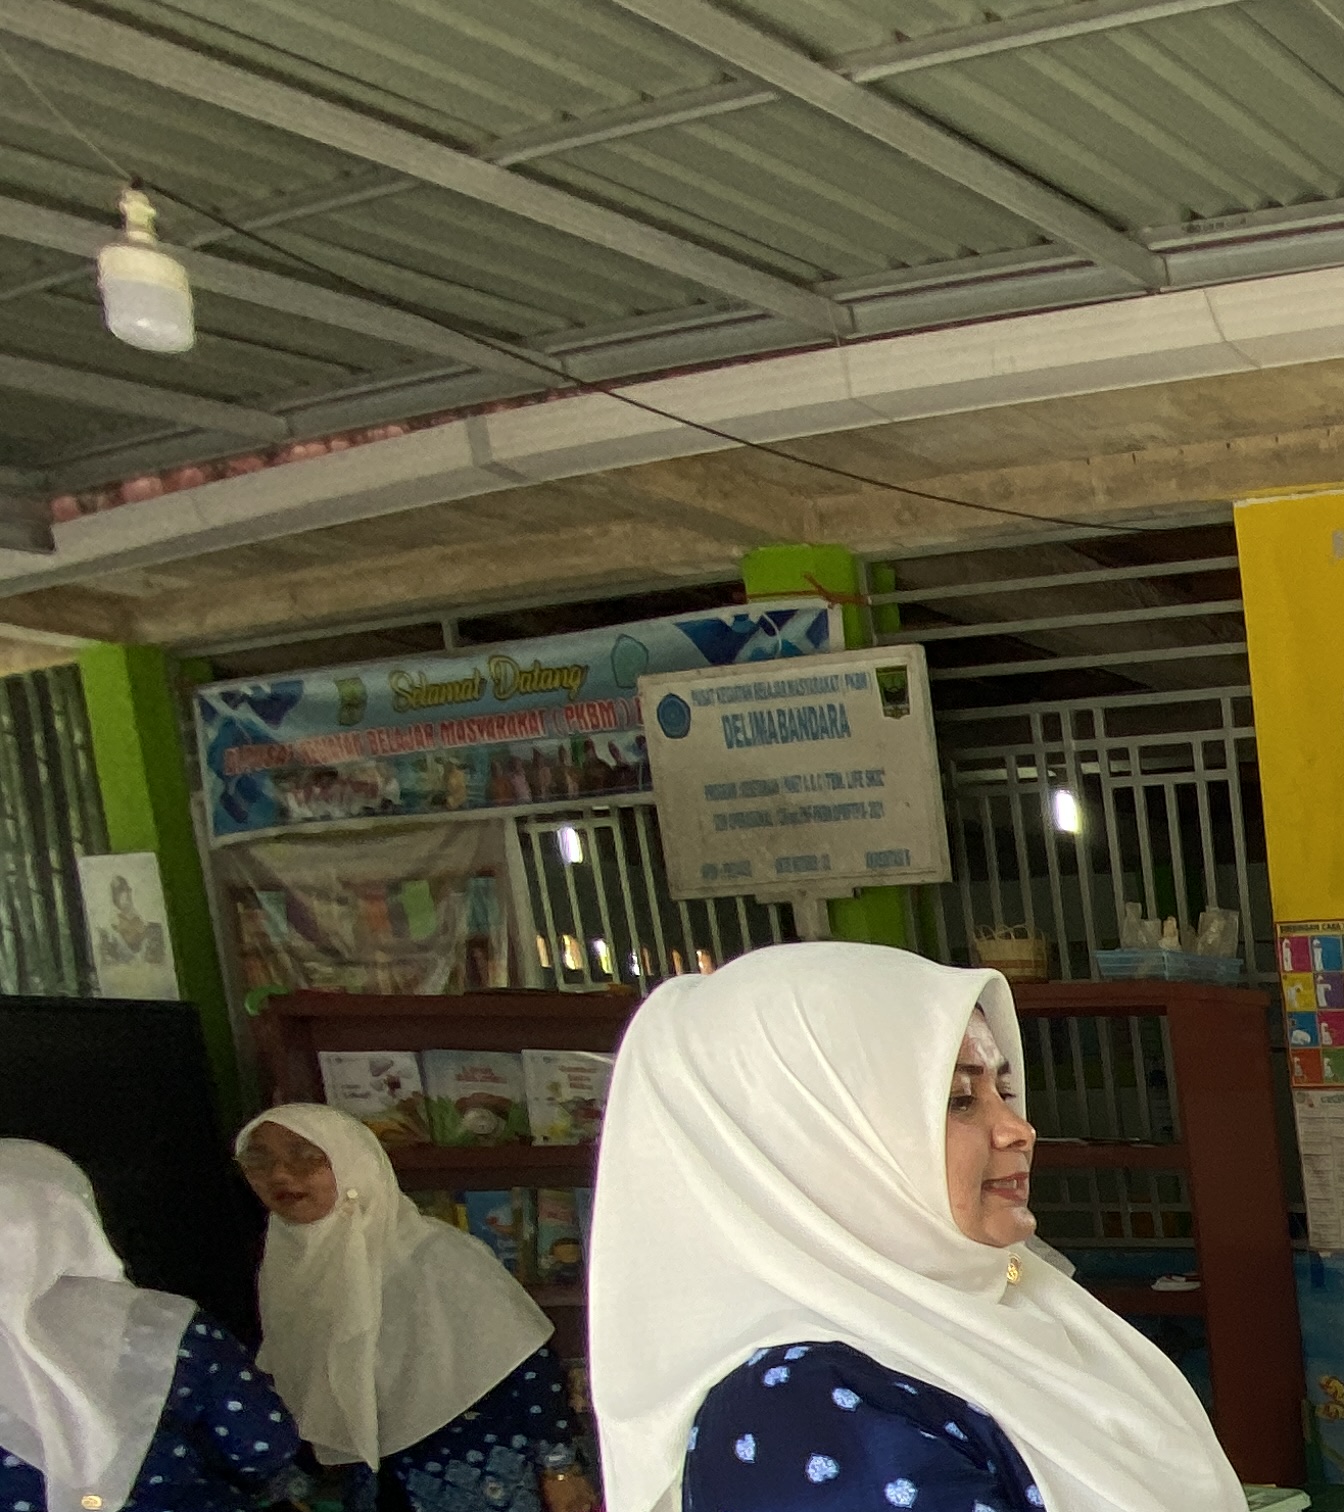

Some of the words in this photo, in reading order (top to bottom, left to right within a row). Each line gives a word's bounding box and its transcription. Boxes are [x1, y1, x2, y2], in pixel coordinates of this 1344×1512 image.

[387, 667, 486, 714] Selamat
[488, 654, 588, 701] Datang
[365, 722, 435, 756] BELAJAR
[439, 708, 546, 748] MASYARAKAT
[563, 699, 617, 733] PKBM
